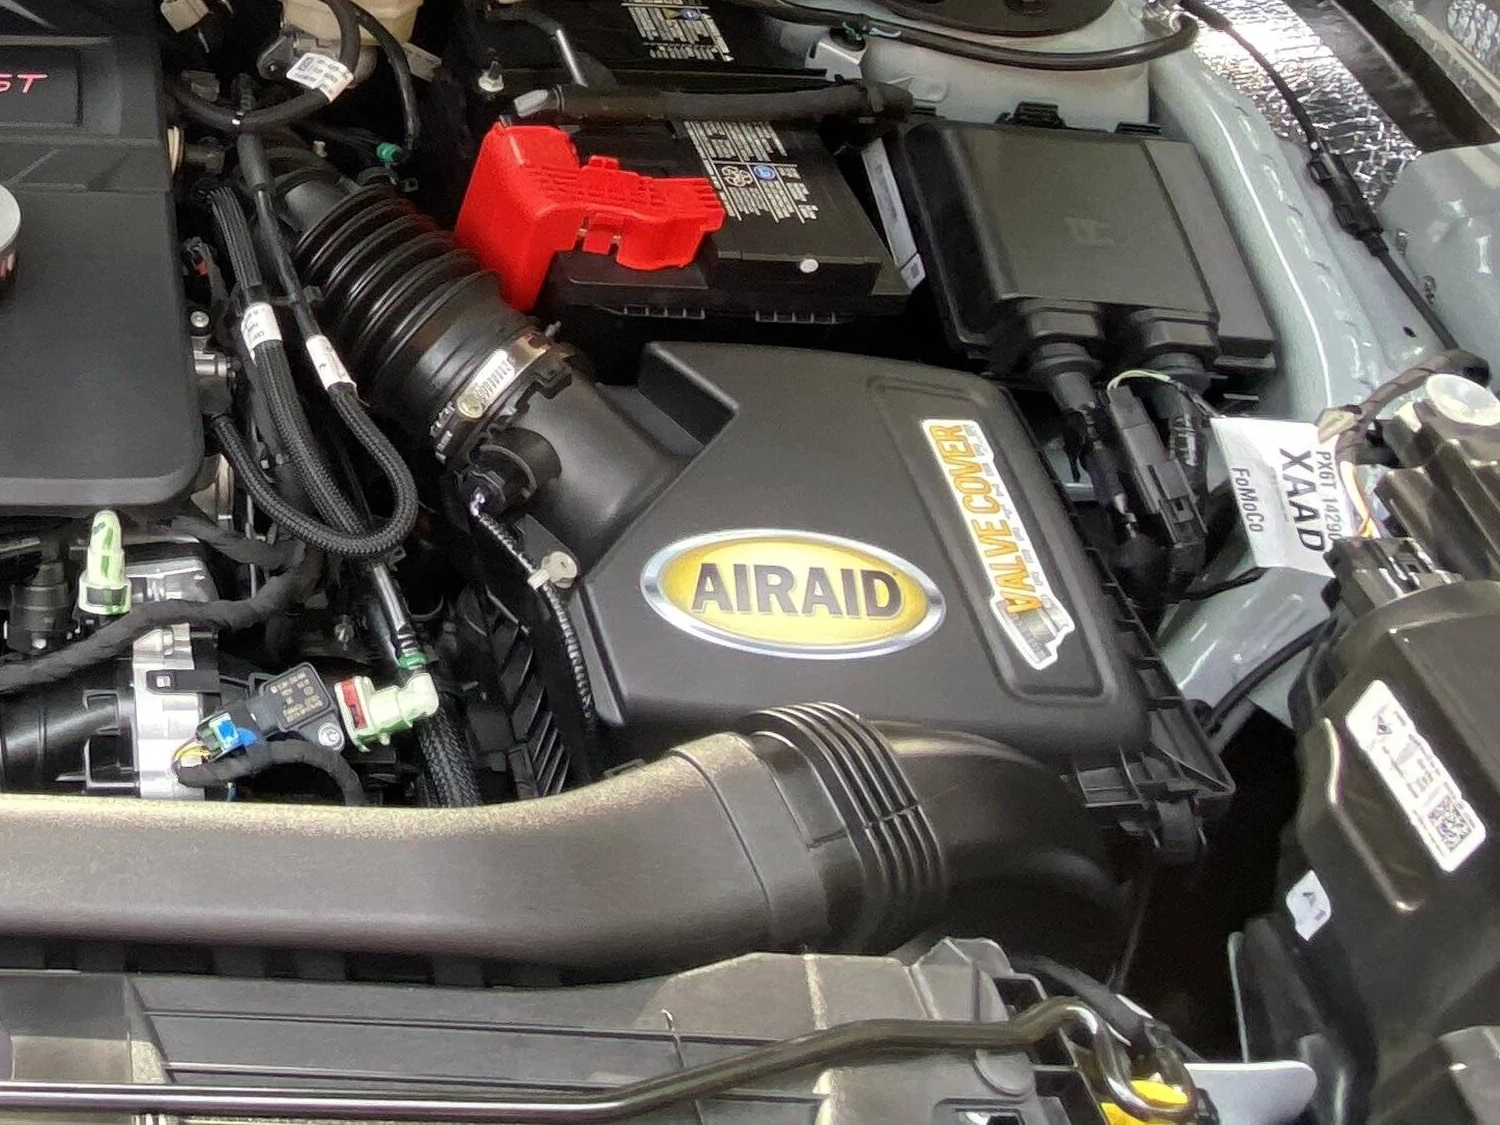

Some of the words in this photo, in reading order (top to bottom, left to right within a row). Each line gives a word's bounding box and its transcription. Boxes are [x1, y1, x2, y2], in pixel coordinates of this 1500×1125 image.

[928, 424, 1002, 515] COVER
[1230, 466, 1265, 533] FoMoCo
[1279, 447, 1326, 552] XAAD
[1315, 450, 1338, 490] PX6T
[1321, 498, 1343, 542] 14290
[691, 562, 904, 619] AIRAID
[971, 518, 1044, 615] VALVE
